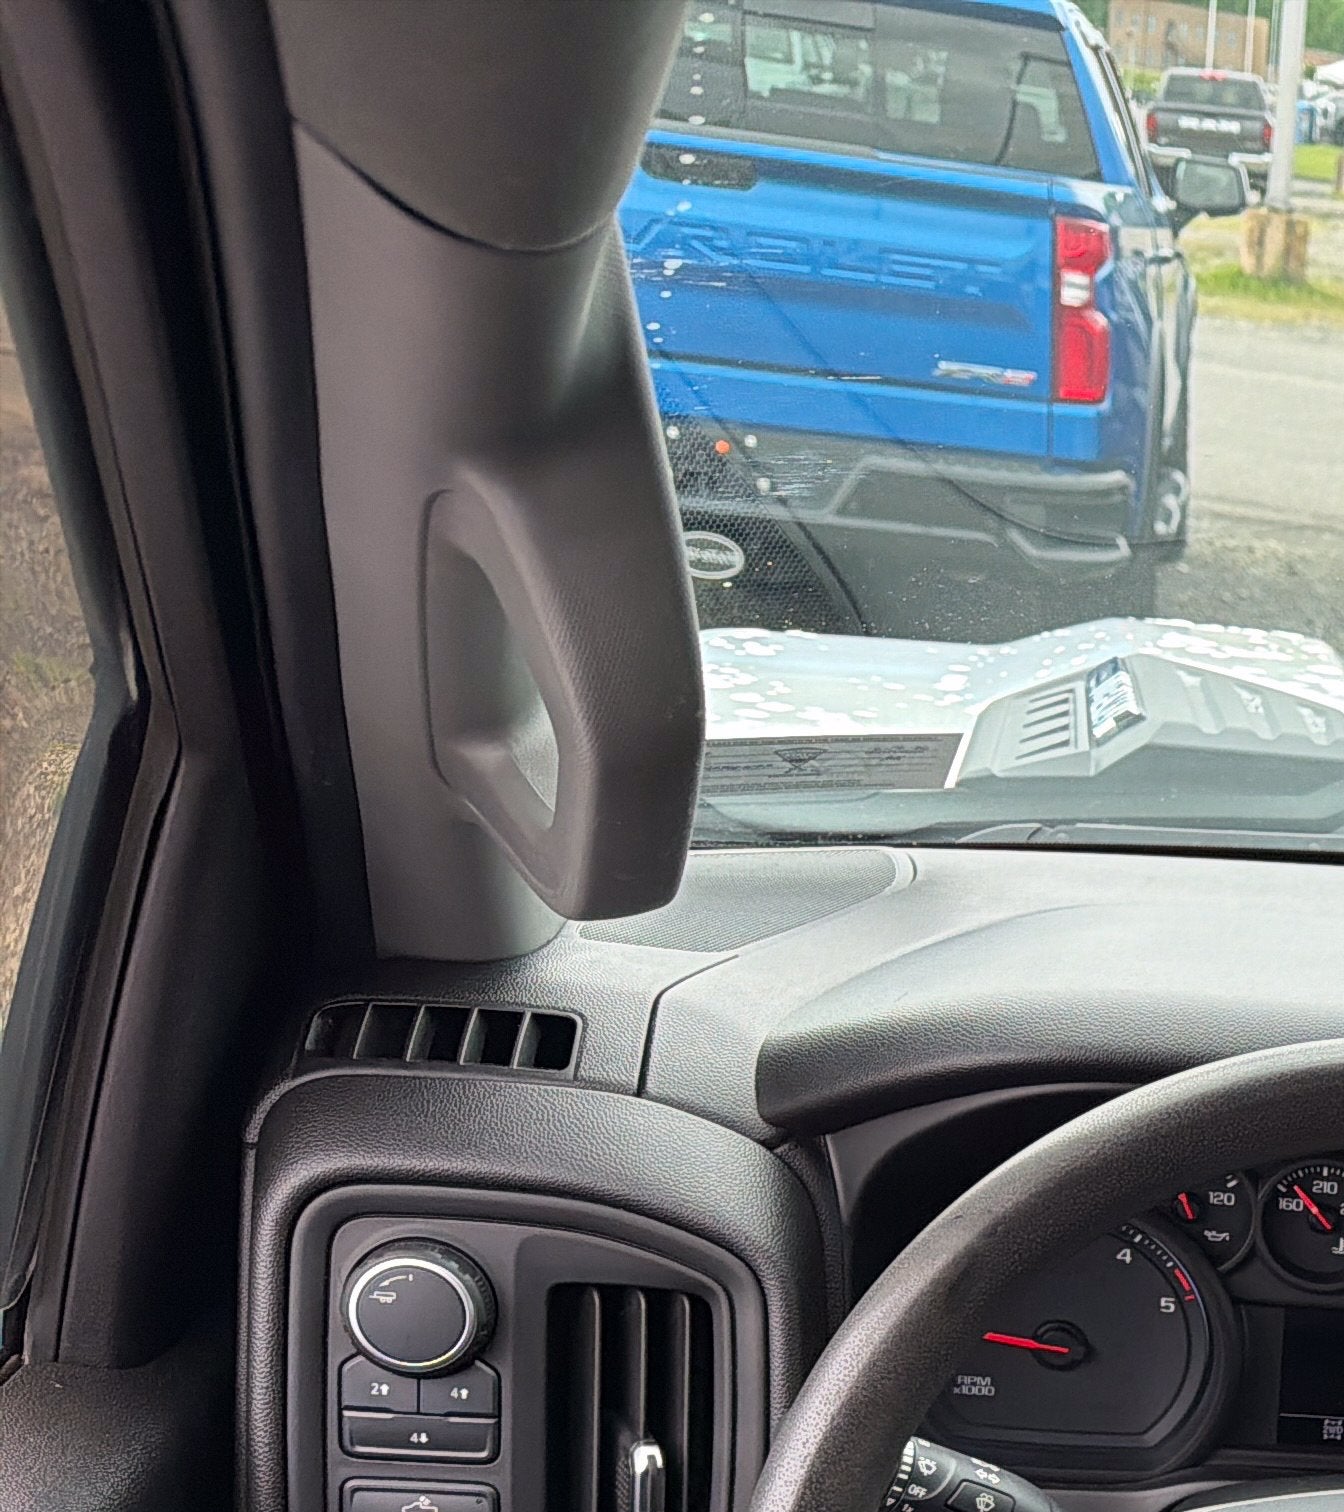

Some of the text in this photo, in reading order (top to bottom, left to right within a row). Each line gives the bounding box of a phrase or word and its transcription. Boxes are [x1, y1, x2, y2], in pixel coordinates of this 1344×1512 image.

[1312, 1180, 1338, 1195] 210
[1208, 1191, 1235, 1206] 120
[1278, 1197, 1304, 1212] 160
[1116, 1248, 1132, 1264] 4
[1160, 1297, 1175, 1313] 5
[957, 1375, 991, 1386] RPM
[908, 1484, 928, 1499] OFF
